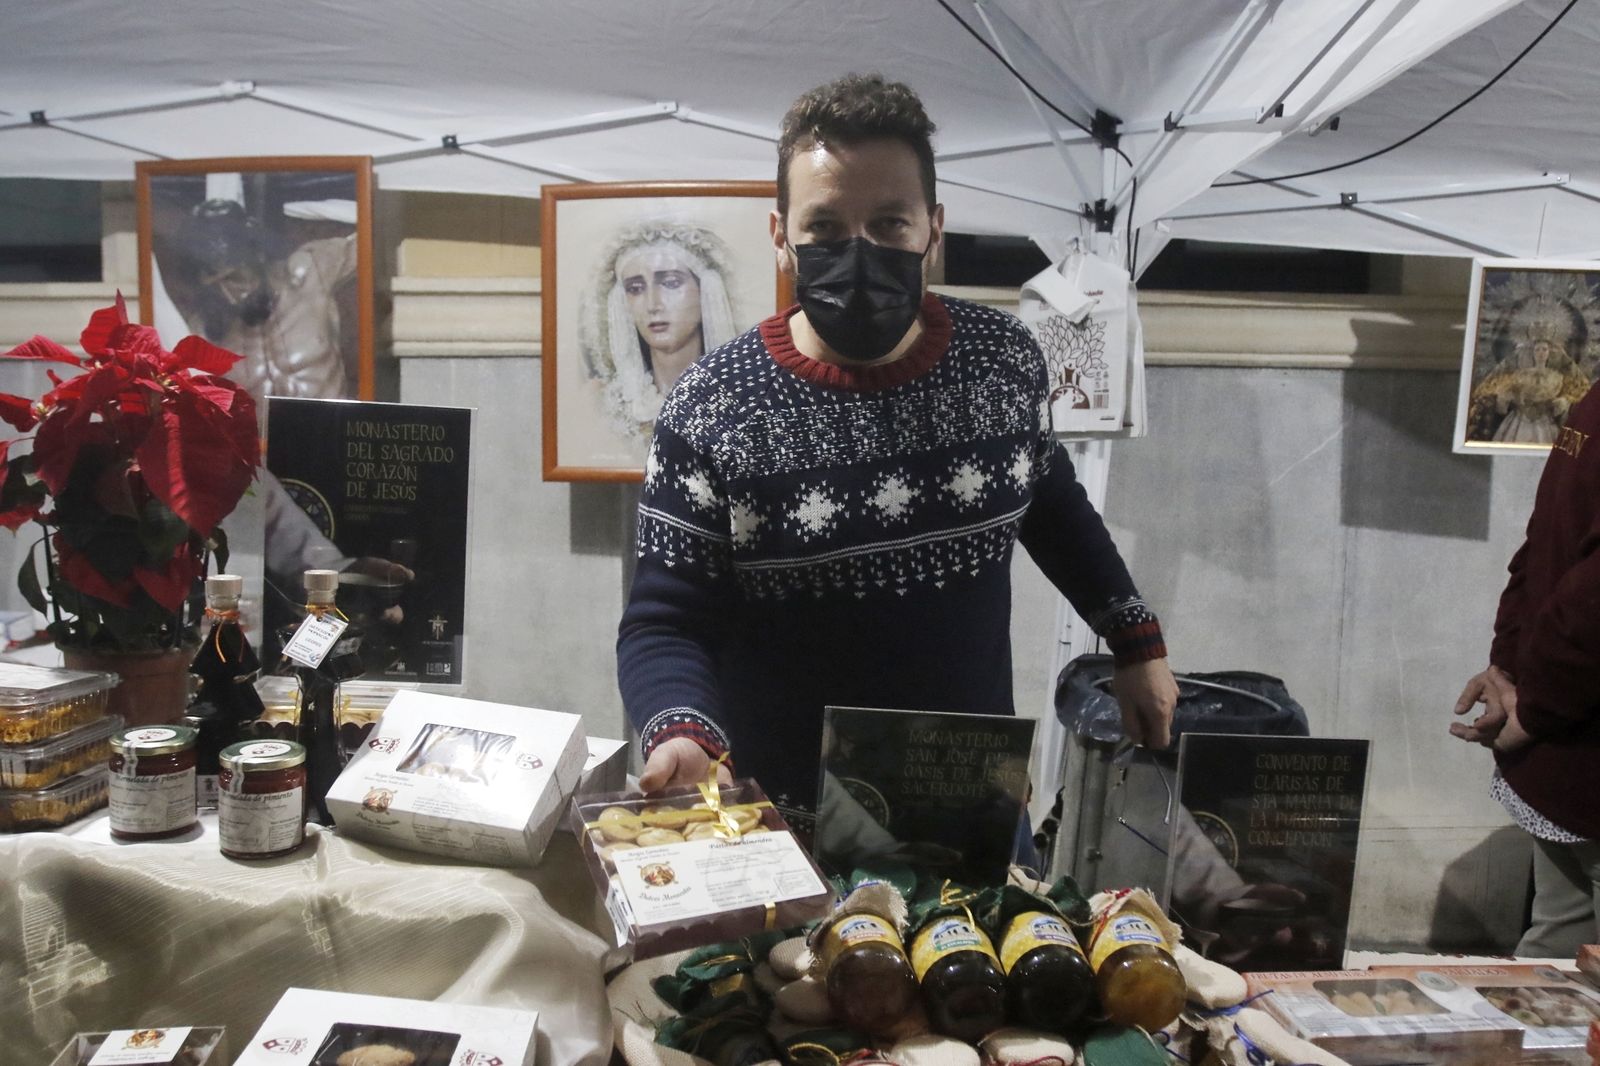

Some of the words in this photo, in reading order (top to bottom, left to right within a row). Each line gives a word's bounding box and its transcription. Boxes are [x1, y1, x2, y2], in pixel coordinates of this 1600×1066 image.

[346, 420, 446, 441] MONASTERIO
[347, 441, 375, 460] DEL
[381, 444, 454, 463] SAGRADO
[346, 460, 417, 482] CORAZÓN
[346, 481, 367, 498] DE
[372, 481, 417, 501] JESÚS
[909, 729, 1009, 748] MONASTERIO
[905, 748, 937, 764] SAN
[943, 747, 977, 766] JOSÉ
[1256, 754, 1328, 772] CONVENTO
[1332, 755, 1353, 772] DE
[952, 766, 974, 781] DE
[1254, 774, 1320, 792] CLARISAS
[1326, 775, 1345, 792] DE
[902, 781, 988, 799] SACERDOTE
[1249, 810, 1267, 827] LA
